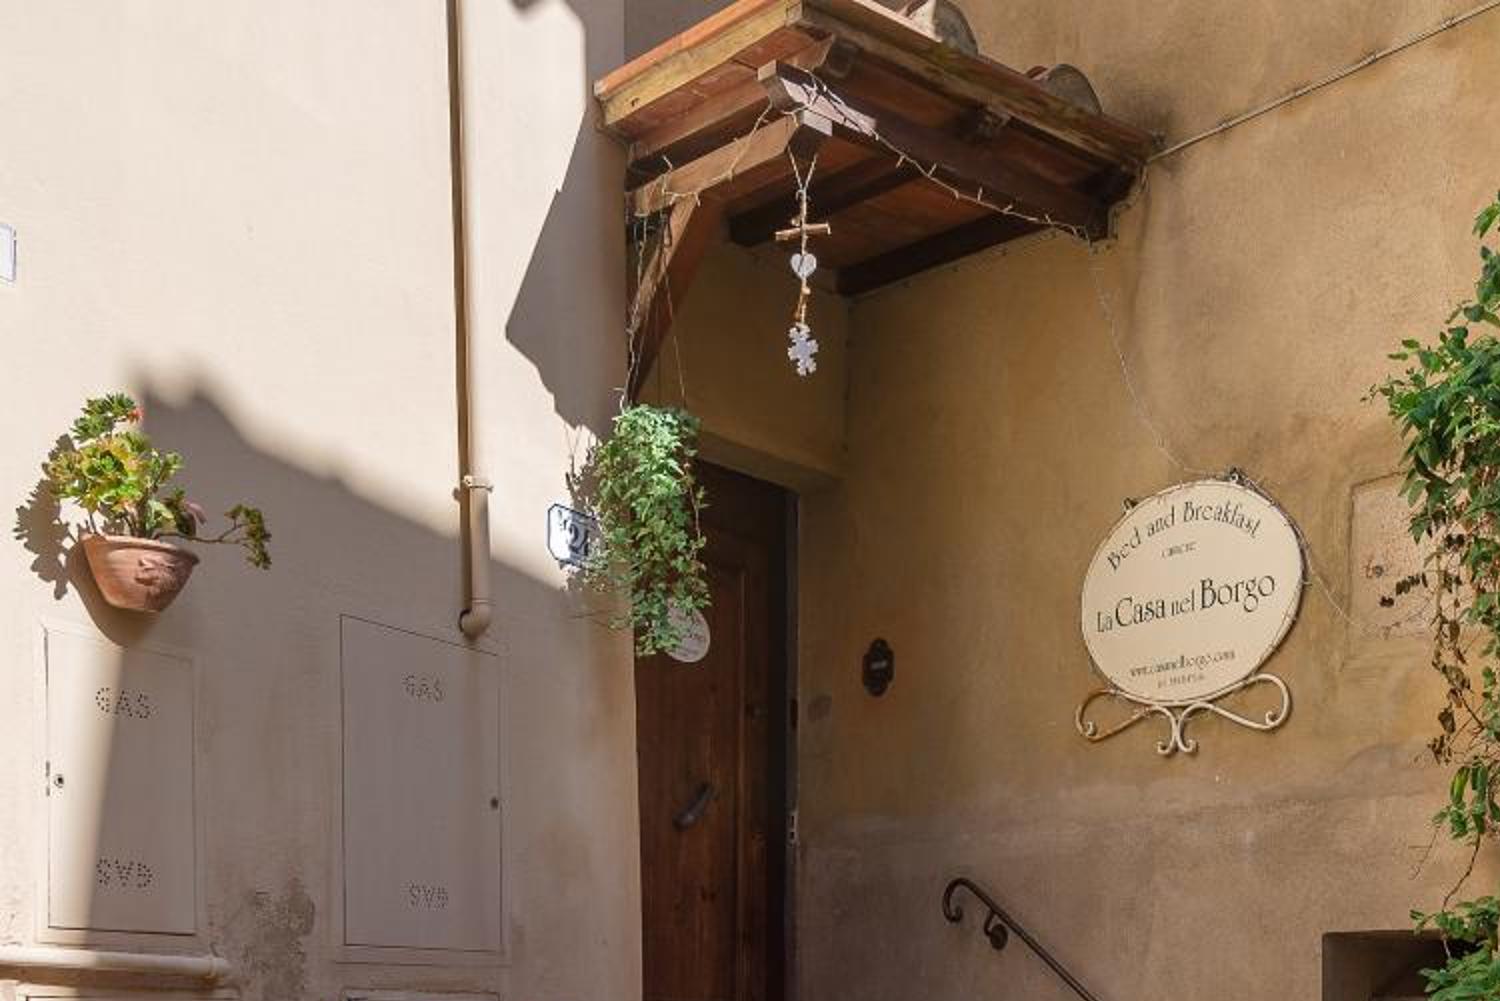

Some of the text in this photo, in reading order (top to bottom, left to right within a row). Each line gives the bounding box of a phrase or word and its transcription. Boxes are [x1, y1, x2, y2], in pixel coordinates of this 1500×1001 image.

[1106, 528, 1142, 572] Bed
[1146, 505, 1176, 537] and
[1182, 500, 1264, 539] Breakfast
[1114, 596, 1167, 628] Casa
[1170, 588, 1196, 617] nel
[1198, 574, 1277, 613] Borgo
[95, 686, 152, 719] GAS
